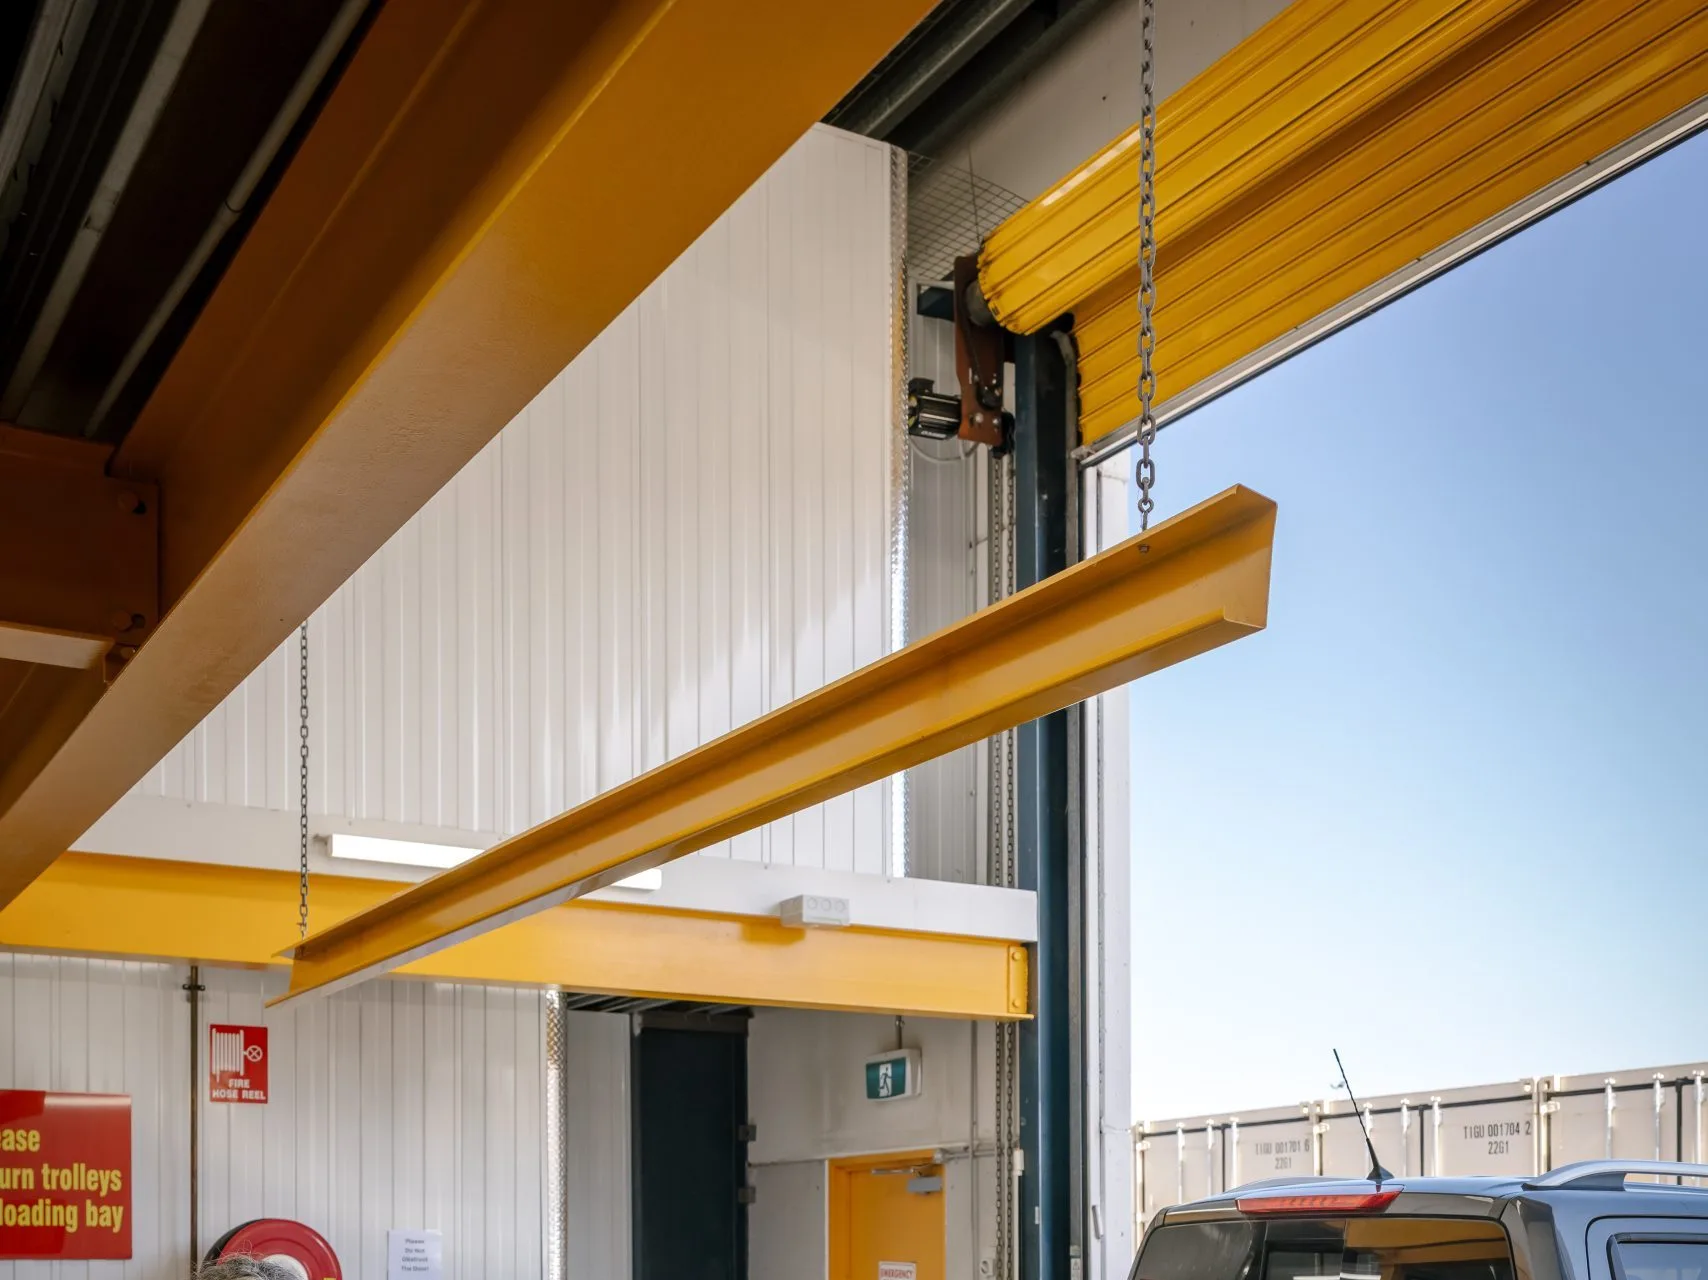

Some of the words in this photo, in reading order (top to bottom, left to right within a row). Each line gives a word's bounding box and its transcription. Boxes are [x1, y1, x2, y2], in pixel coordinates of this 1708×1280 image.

[228, 1079, 250, 1088] FIRE
[212, 1089, 238, 1099] HOSE
[242, 1090, 266, 1100] REEL
[1463, 1125, 1485, 1139] TIGU
[1487, 1122, 1520, 1137] 001704
[1525, 1120, 1531, 1135] 2
[0, 1129, 40, 1152] ase
[1488, 1140, 1509, 1155] 22G1
[41, 1162, 122, 1197] trolleys
[0, 1198, 78, 1233] loading
[85, 1199, 124, 1233] bay
